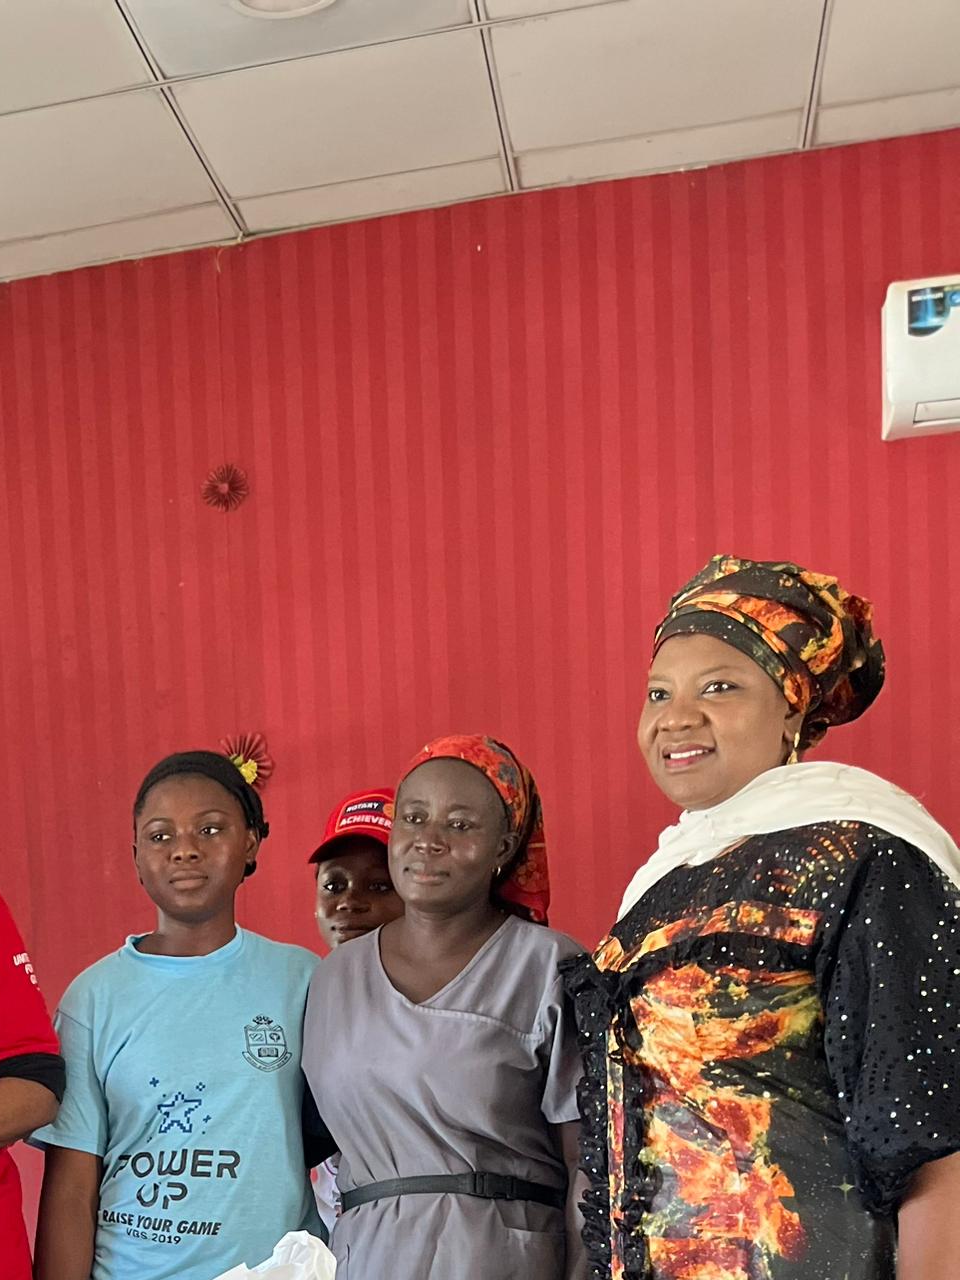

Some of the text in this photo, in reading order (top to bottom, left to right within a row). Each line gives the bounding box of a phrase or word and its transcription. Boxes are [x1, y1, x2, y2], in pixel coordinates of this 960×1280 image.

[345, 800, 379, 813] ROTARY
[113, 1149, 241, 1179] POWER
[136, 1181, 188, 1210] UP
[102, 1209, 222, 1236] RAISE YOUR GAME
[151, 1232, 182, 1245] 2019
